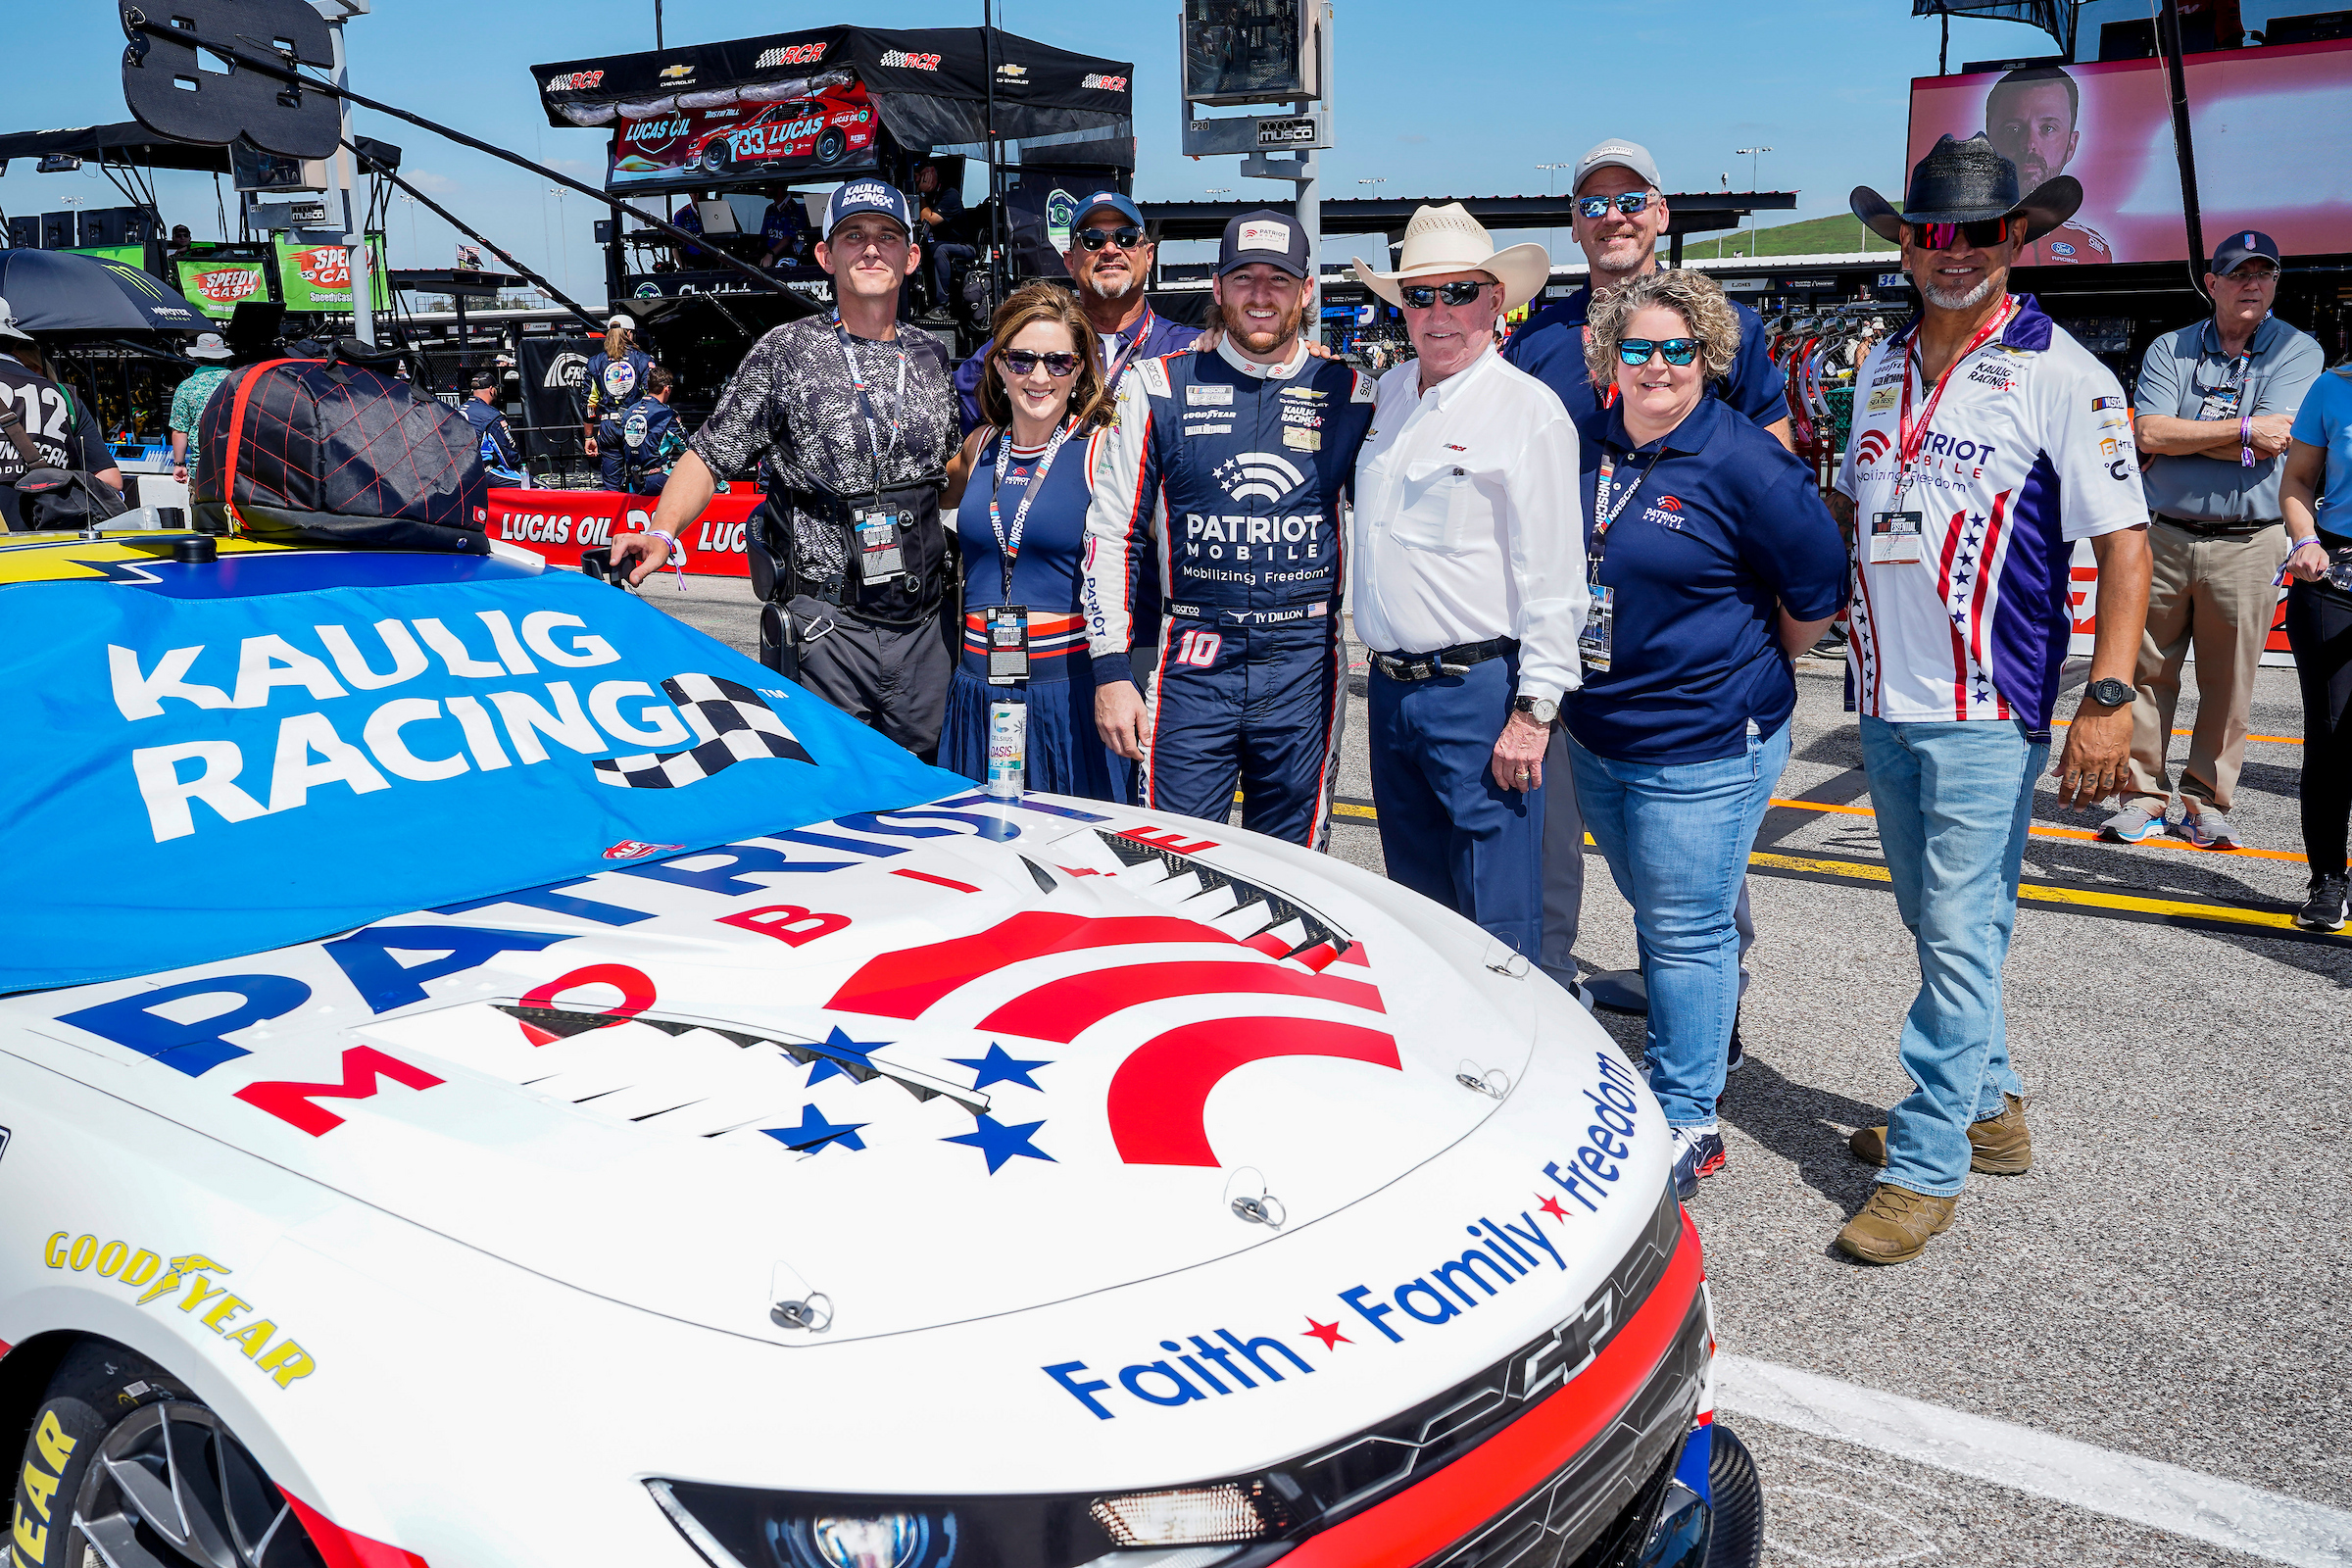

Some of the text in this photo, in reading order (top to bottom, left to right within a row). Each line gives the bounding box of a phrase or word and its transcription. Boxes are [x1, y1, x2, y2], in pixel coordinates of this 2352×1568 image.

[781, 42, 827, 65] RCR
[906, 53, 941, 72] RCR
[2001, 62, 2027, 71] ASUS
[570, 71, 604, 90] RCR
[1100, 74, 1127, 92] RCR
[624, 118, 691, 142] LUCAS OIL
[768, 116, 824, 145] LUCAS
[831, 115, 849, 124] LUCAS
[1192, 122, 1208, 130] P20
[738, 127, 765, 156] 33
[841, 194, 884, 208] RACING
[845, 186, 885, 198] KAULIG
[1259, 228, 1286, 237] PATRIOT
[2055, 244, 2071, 254] Ford
[206, 270, 257, 288] SPEEDY
[1879, 275, 1897, 287] 34
[845, 347, 863, 381] NASCAR
[1976, 362, 2014, 377] KAULIG
[1980, 351, 2030, 371] CHEVROLET
[1968, 371, 2007, 388] RACING
[2226, 358, 2249, 388] NASCAR
[1359, 374, 1373, 398] spar
[1280, 398, 1329, 408] CHEVROLET
[1283, 406, 1316, 416] KAULIG
[1870, 396, 1894, 406] SEA BEST
[1183, 409, 1237, 420] GOODYEAR
[1281, 414, 1314, 423] RACING
[865, 416, 878, 454] NASCAR
[1042, 424, 1067, 467] NASCAR
[996, 438, 1011, 479] NASCAR
[1898, 429, 1996, 466] TRIOT
[1894, 452, 1984, 479] MOBILE
[1594, 479, 1611, 527] NASCAR
[1608, 474, 1642, 521] NASCAR
[1009, 498, 1031, 545] NASCAR
[1642, 514, 1683, 530] MOBILE
[1645, 506, 1686, 526] PATRIOT
[501, 513, 571, 544] LUCAS
[576, 516, 612, 547] OIL
[697, 521, 748, 554] LUC
[991, 514, 1007, 557] NASCA
[1186, 513, 1324, 545] PATRIOT
[1186, 542, 1319, 561] MOBILE
[1183, 564, 1256, 586] Mobilizing
[1171, 604, 1200, 616] sparco
[1253, 610, 1304, 624] TY DILLON
[1174, 629, 1222, 667] 10
[106, 610, 621, 722] KAULIG
[131, 680, 692, 843] RACING
[990, 745, 1012, 758] OASIS
[54, 790, 1114, 1079] PATRIOT
[1542, 1051, 1642, 1213] Freedom
[1338, 1216, 1569, 1344] Family
[45, 1231, 317, 1390] GOODYEAR
[1041, 1328, 1316, 1421] Faith
